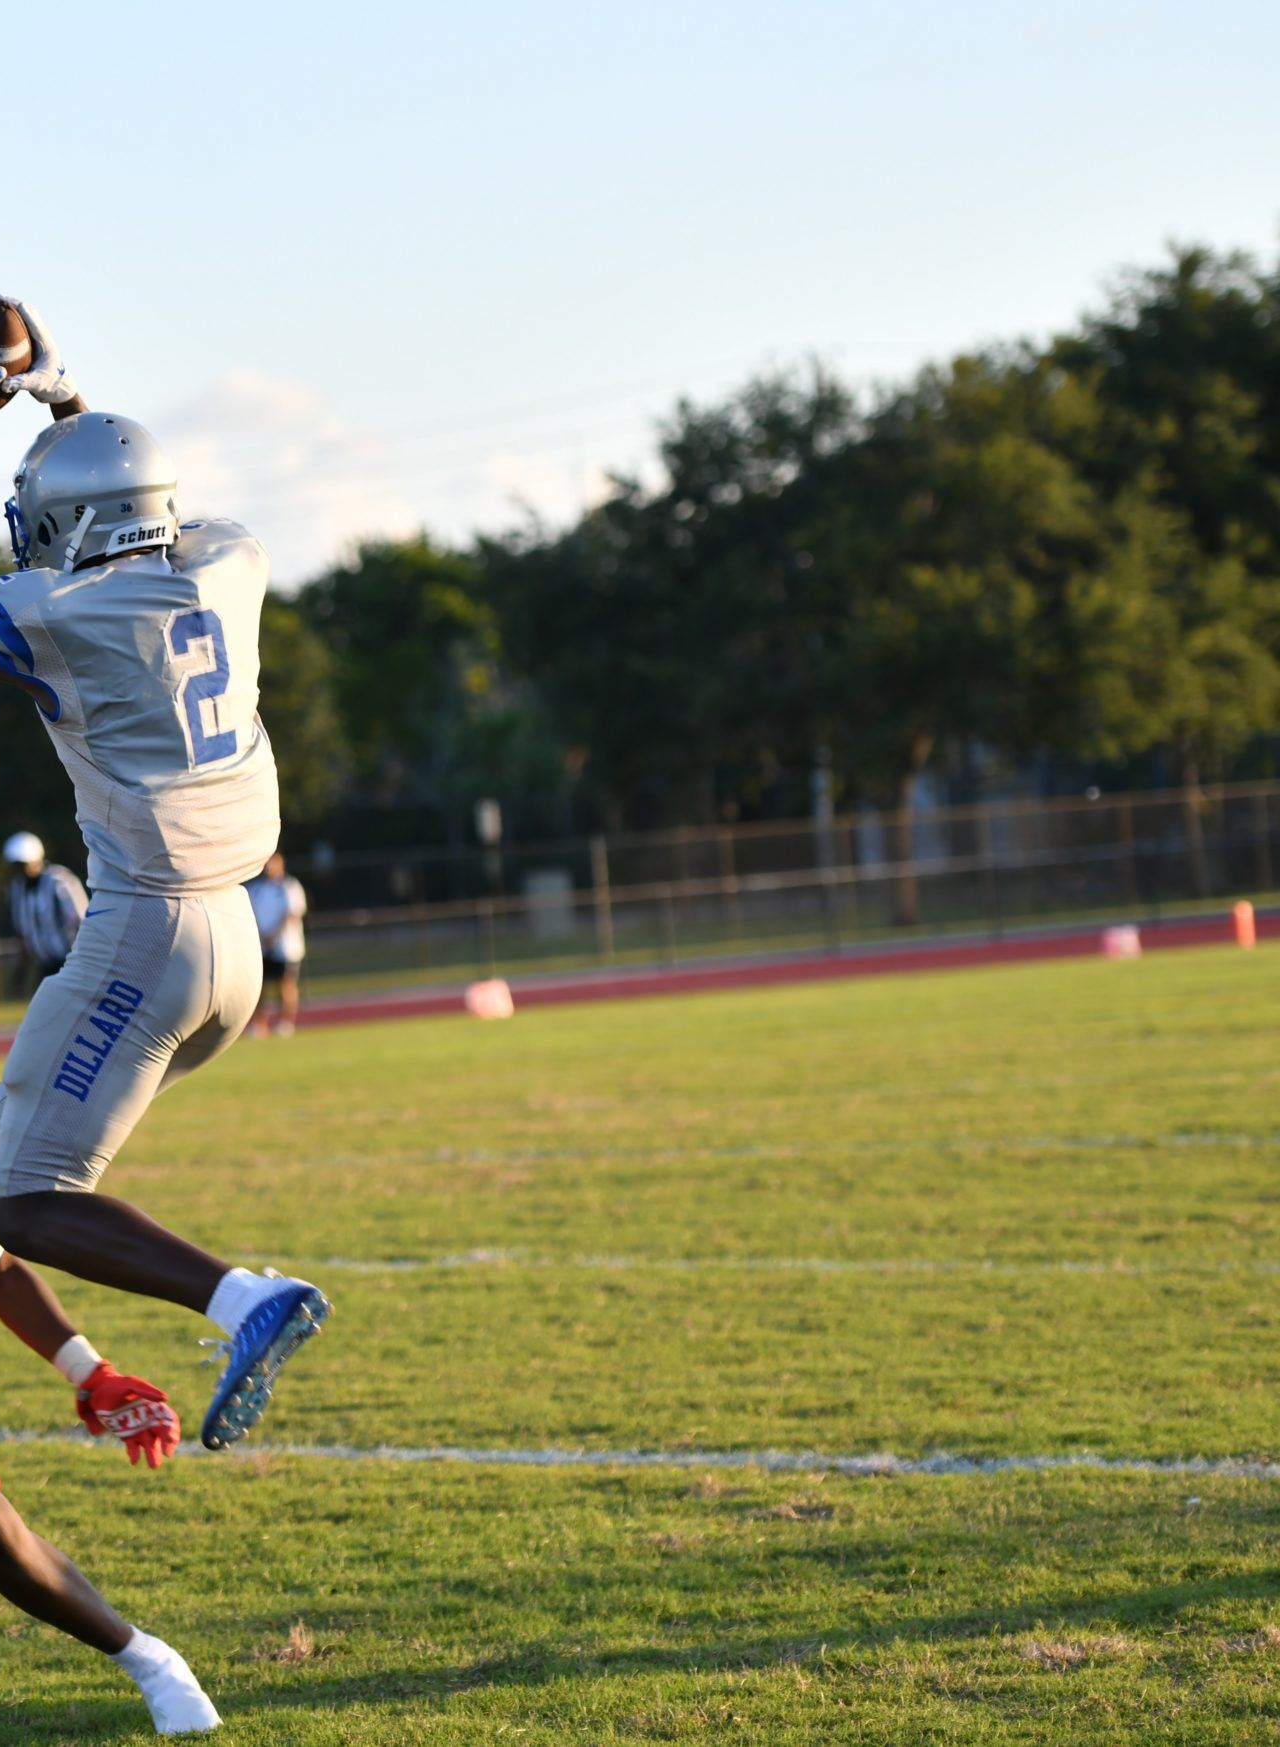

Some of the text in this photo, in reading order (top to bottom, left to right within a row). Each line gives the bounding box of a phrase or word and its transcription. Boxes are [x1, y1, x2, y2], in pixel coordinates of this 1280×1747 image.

[118, 525, 168, 545] schutt
[120, 502, 134, 514] 36
[164, 607, 237, 774] 2
[54, 980, 145, 1103] DILLARD
